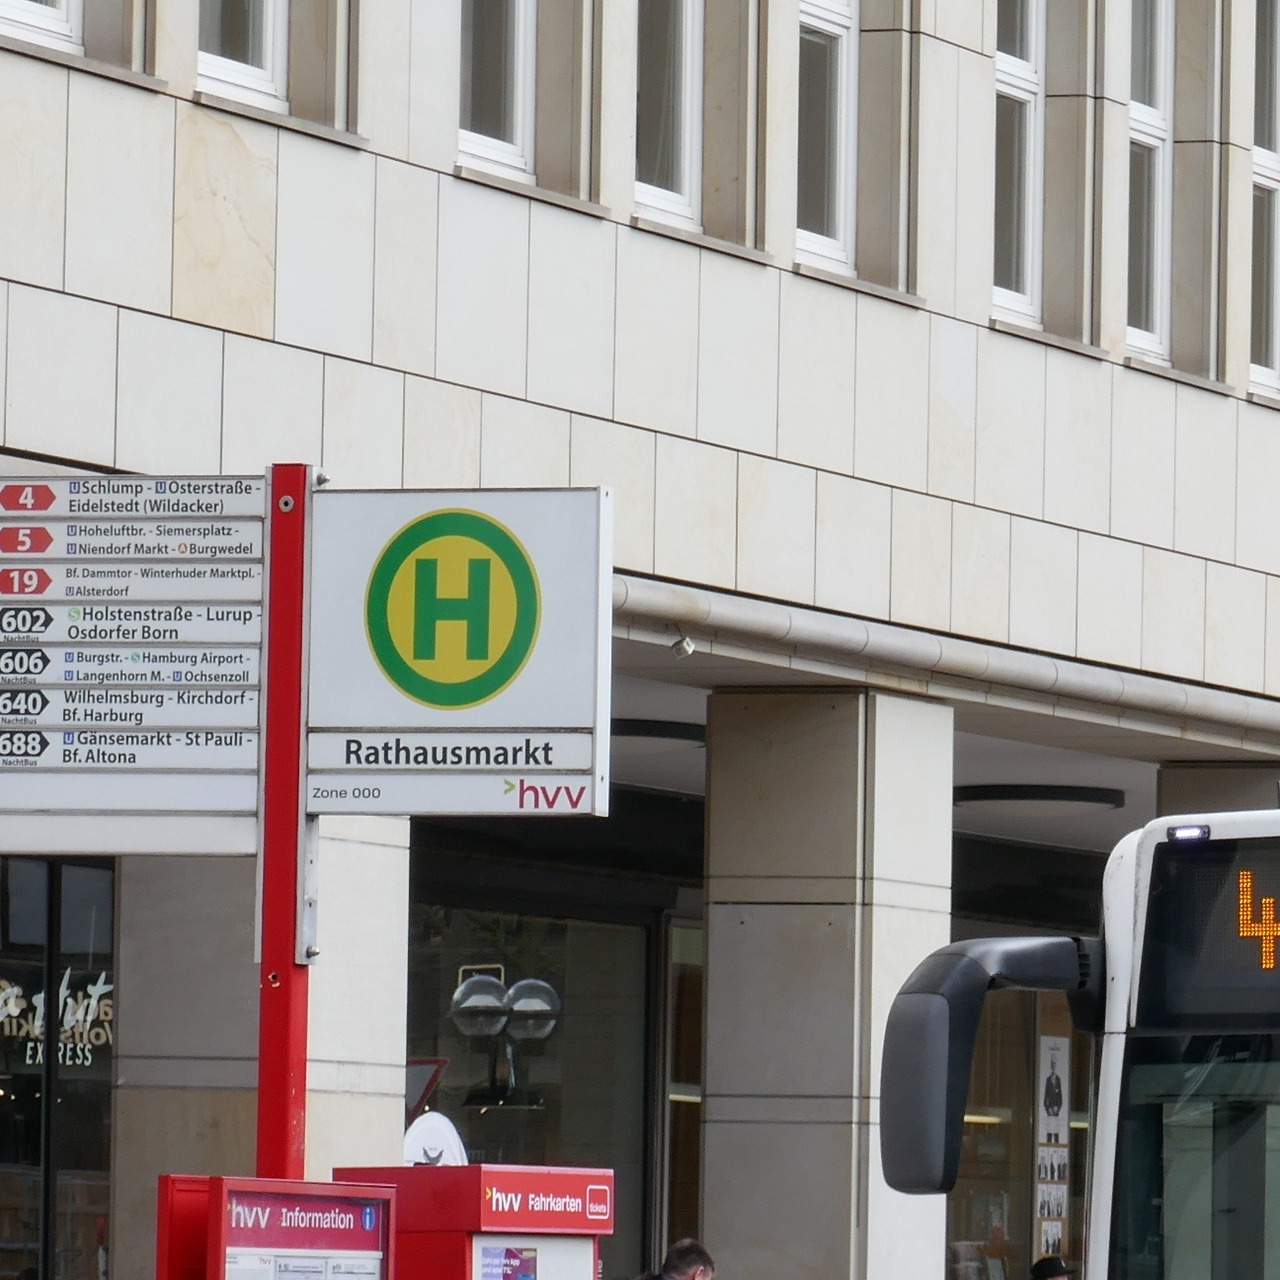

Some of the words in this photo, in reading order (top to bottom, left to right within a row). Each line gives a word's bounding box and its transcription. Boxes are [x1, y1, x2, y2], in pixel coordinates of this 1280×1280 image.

[82, 481, 143, 497] Schlump
[169, 481, 252, 494] Osterstraße
[19, 488, 34, 508] 4
[69, 499, 140, 512] Eidelstedt
[144, 499, 224, 515] (Wildacker)
[18, 530, 31, 550] 5
[79, 525, 146, 537] Hoheluftbr.
[156, 525, 232, 539] Siemersplatz
[79, 543, 132, 555] Niendorf
[134, 543, 169, 555] Markt
[189, 543, 253, 557] Burgwedel
[9, 571, 39, 592] 19
[66, 568, 79, 578] Bf.
[82, 568, 132, 579] Dammtor
[141, 568, 207, 579] Winterhuder
[210, 568, 255, 581] Marktpl.
[76, 586, 129, 597] Alsterdorf
[83, 607, 193, 622] Holstenstraße
[206, 608, 253, 624] Lurup
[412, 559, 491, 660] H
[2, 610, 46, 632] 602
[68, 625, 137, 639] Osdorfer
[141, 626, 179, 639] Born
[0, 652, 42, 673] 606
[77, 652, 123, 666] Burgstr.
[143, 652, 197, 666] Hamburg
[201, 652, 243, 666] Airport
[1, 676, 36, 684] NachtBus
[76, 670, 147, 684] Langenhorn
[149, 671, 165, 681] M.
[184, 671, 249, 683] Ochsenzoll
[0, 693, 42, 714] 640
[64, 691, 164, 707] Wilhelmsburg
[177, 691, 245, 705] Kirchdorf
[1, 717, 37, 725] NachtBus
[63, 709, 80, 721] Bf.
[84, 709, 143, 724] Harburg
[0, 734, 41, 755] 688
[78, 731, 172, 746] Gänsemarkt
[185, 732, 200, 746] St
[205, 732, 242, 746] Pauli
[63, 750, 80, 763] Bf.
[86, 750, 136, 763] Altona
[345, 738, 553, 765] Rathausmarkt
[313, 788, 347, 799] Zone
[352, 788, 380, 799] 000
[518, 780, 586, 809] hvv
[26, 1041, 92, 1066] EXRESS
[492, 1187, 521, 1212] hvv
[529, 1194, 582, 1212] Fahrkarten
[231, 1200, 270, 1229] hvv
[281, 1208, 354, 1229] Information
